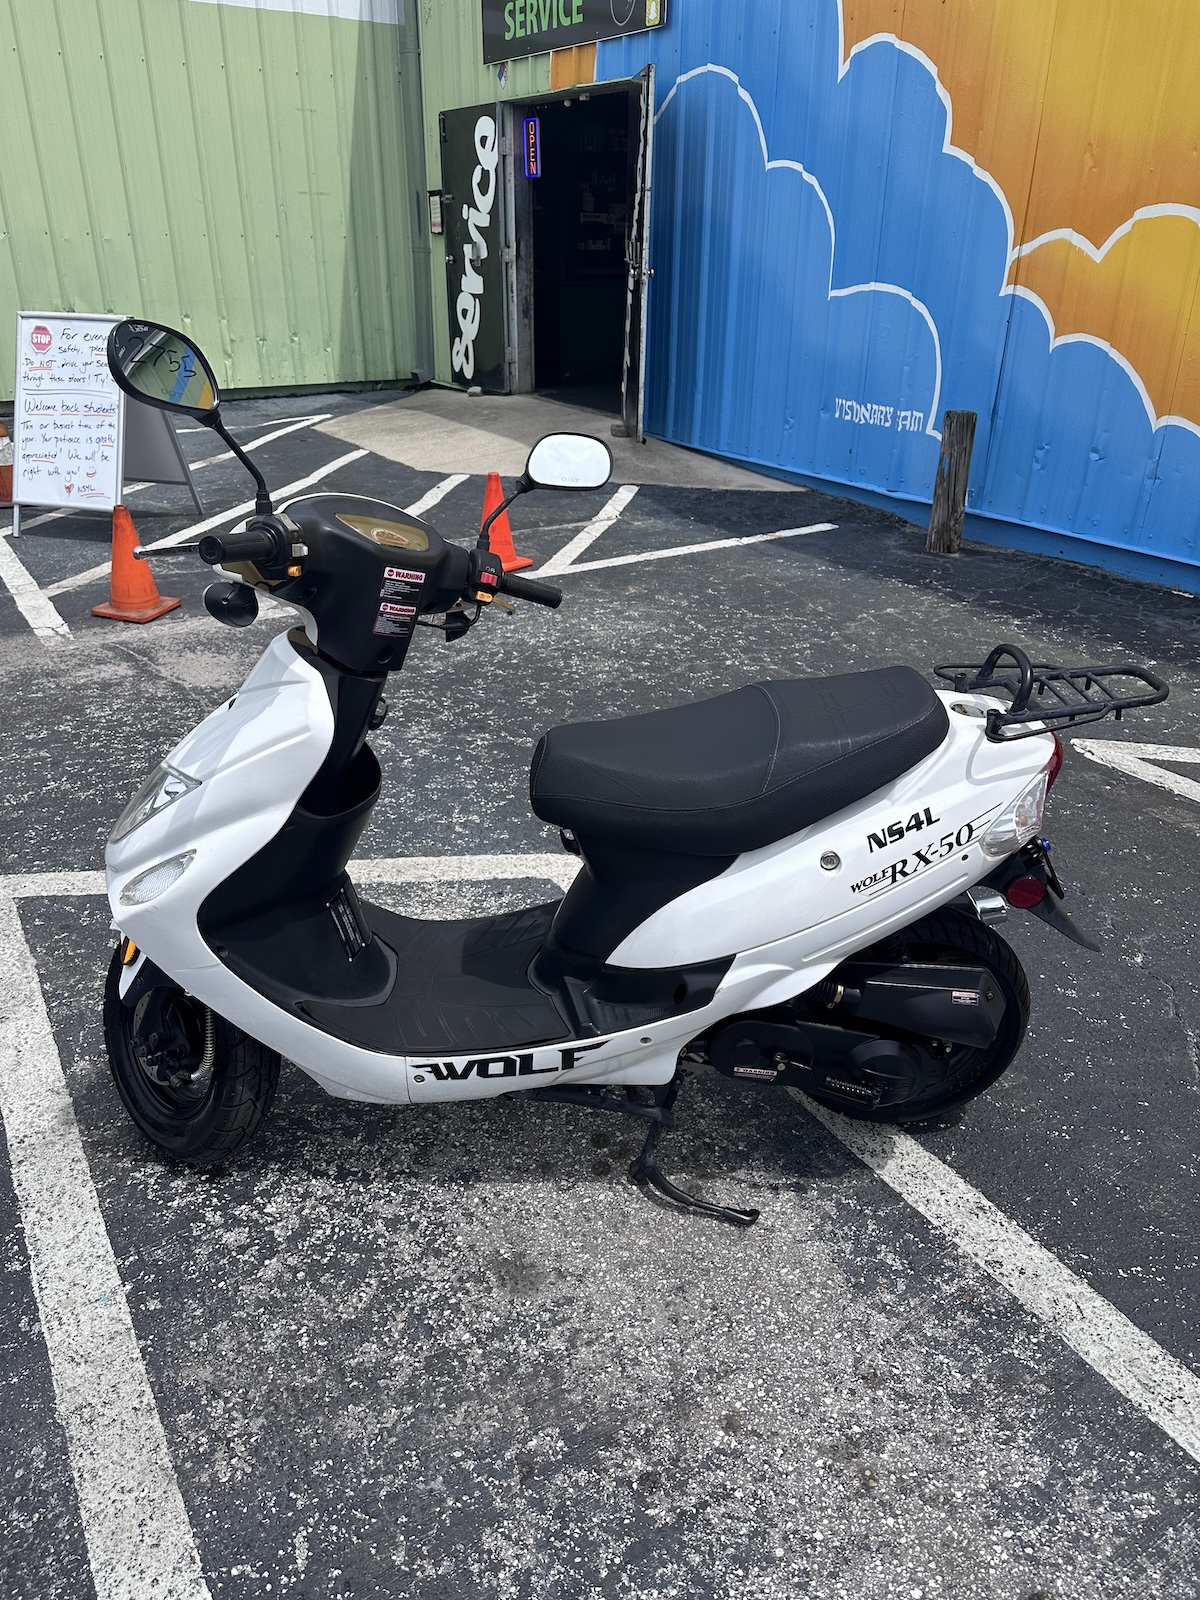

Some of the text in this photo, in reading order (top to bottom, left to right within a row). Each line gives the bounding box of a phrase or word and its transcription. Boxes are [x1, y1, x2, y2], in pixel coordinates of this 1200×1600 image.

[505, 0, 584, 41] SERVICE
[528, 121, 537, 175] OPEN
[452, 116, 498, 380] service
[32, 333, 51, 344] STOP
[60, 327, 78, 341] For
[128, 336, 197, 378] 2755
[24, 398, 58, 413] Welcome
[61, 399, 80, 412] back
[96, 420, 105, 429] of
[85, 436, 93, 444] is
[67, 448, 82, 460] We
[100, 450, 110, 462] be
[22, 465, 41, 481] right
[395, 570, 424, 581] WARNING
[390, 605, 415, 613] WARNING
[866, 806, 941, 853] NS4L
[850, 866, 890, 894] WOLF
[410, 1038, 614, 1081] WOLF
